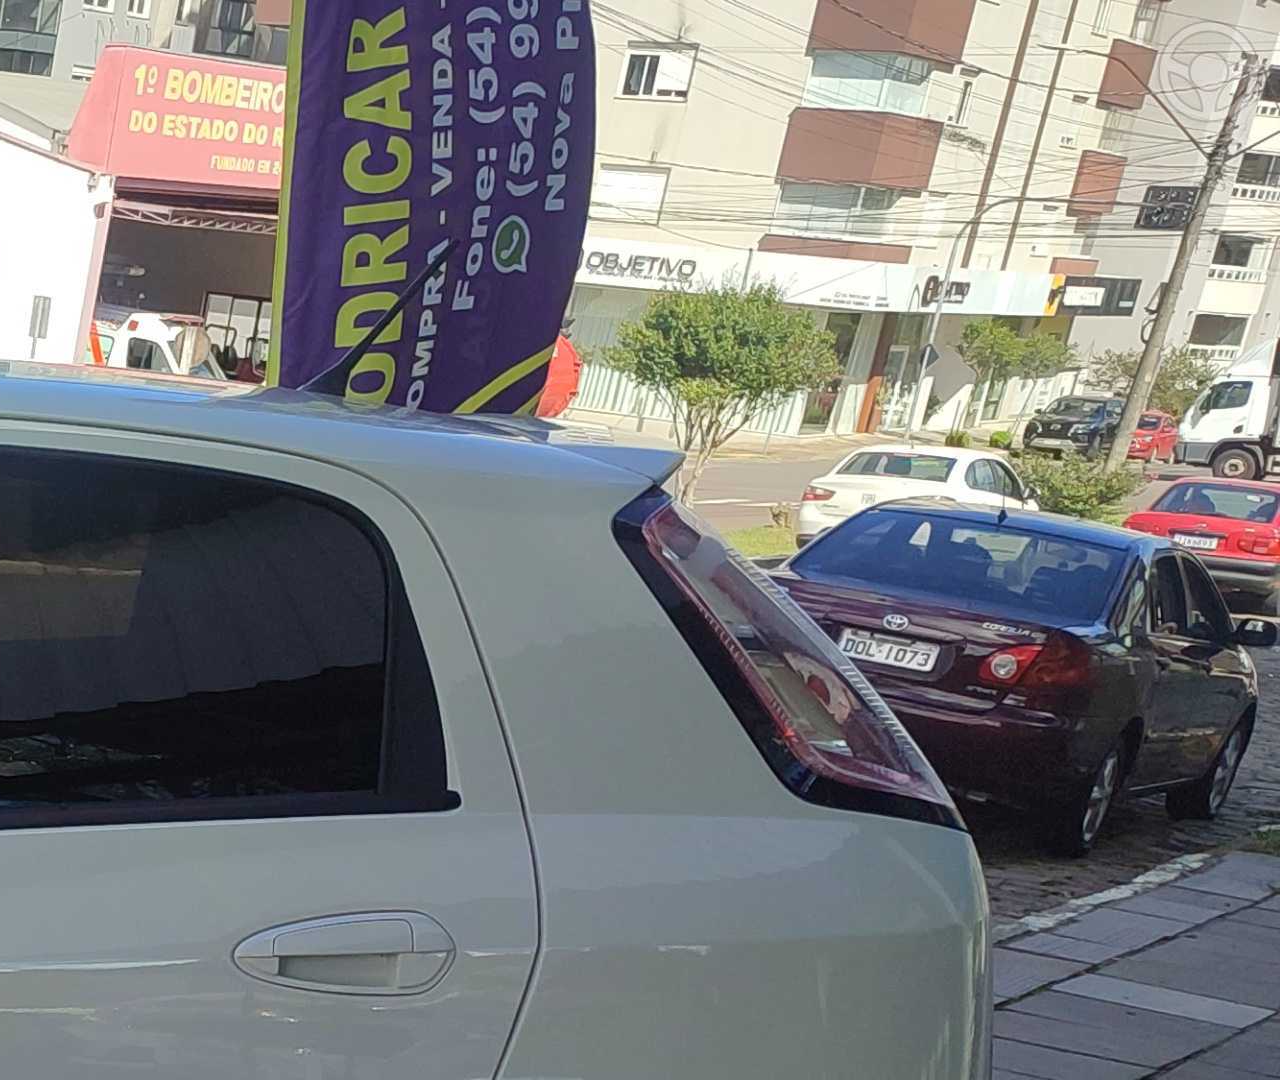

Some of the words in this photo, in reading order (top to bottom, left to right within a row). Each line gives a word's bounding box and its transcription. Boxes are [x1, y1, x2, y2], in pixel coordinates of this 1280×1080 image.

[163, 67, 286, 114] BOMBEIRO
[430, 23, 453, 197] VENDA
[465, 6, 506, 124] (54)
[128, 109, 158, 135] DO
[161, 113, 239, 142] ESTADO
[242, 122, 269, 146] DO
[505, 81, 547, 197] (54)
[544, 72, 575, 211] Nova
[334, 6, 412, 405] ODRICAR
[452, 147, 498, 311] Fone:
[586, 251, 697, 280] OBJETIVO
